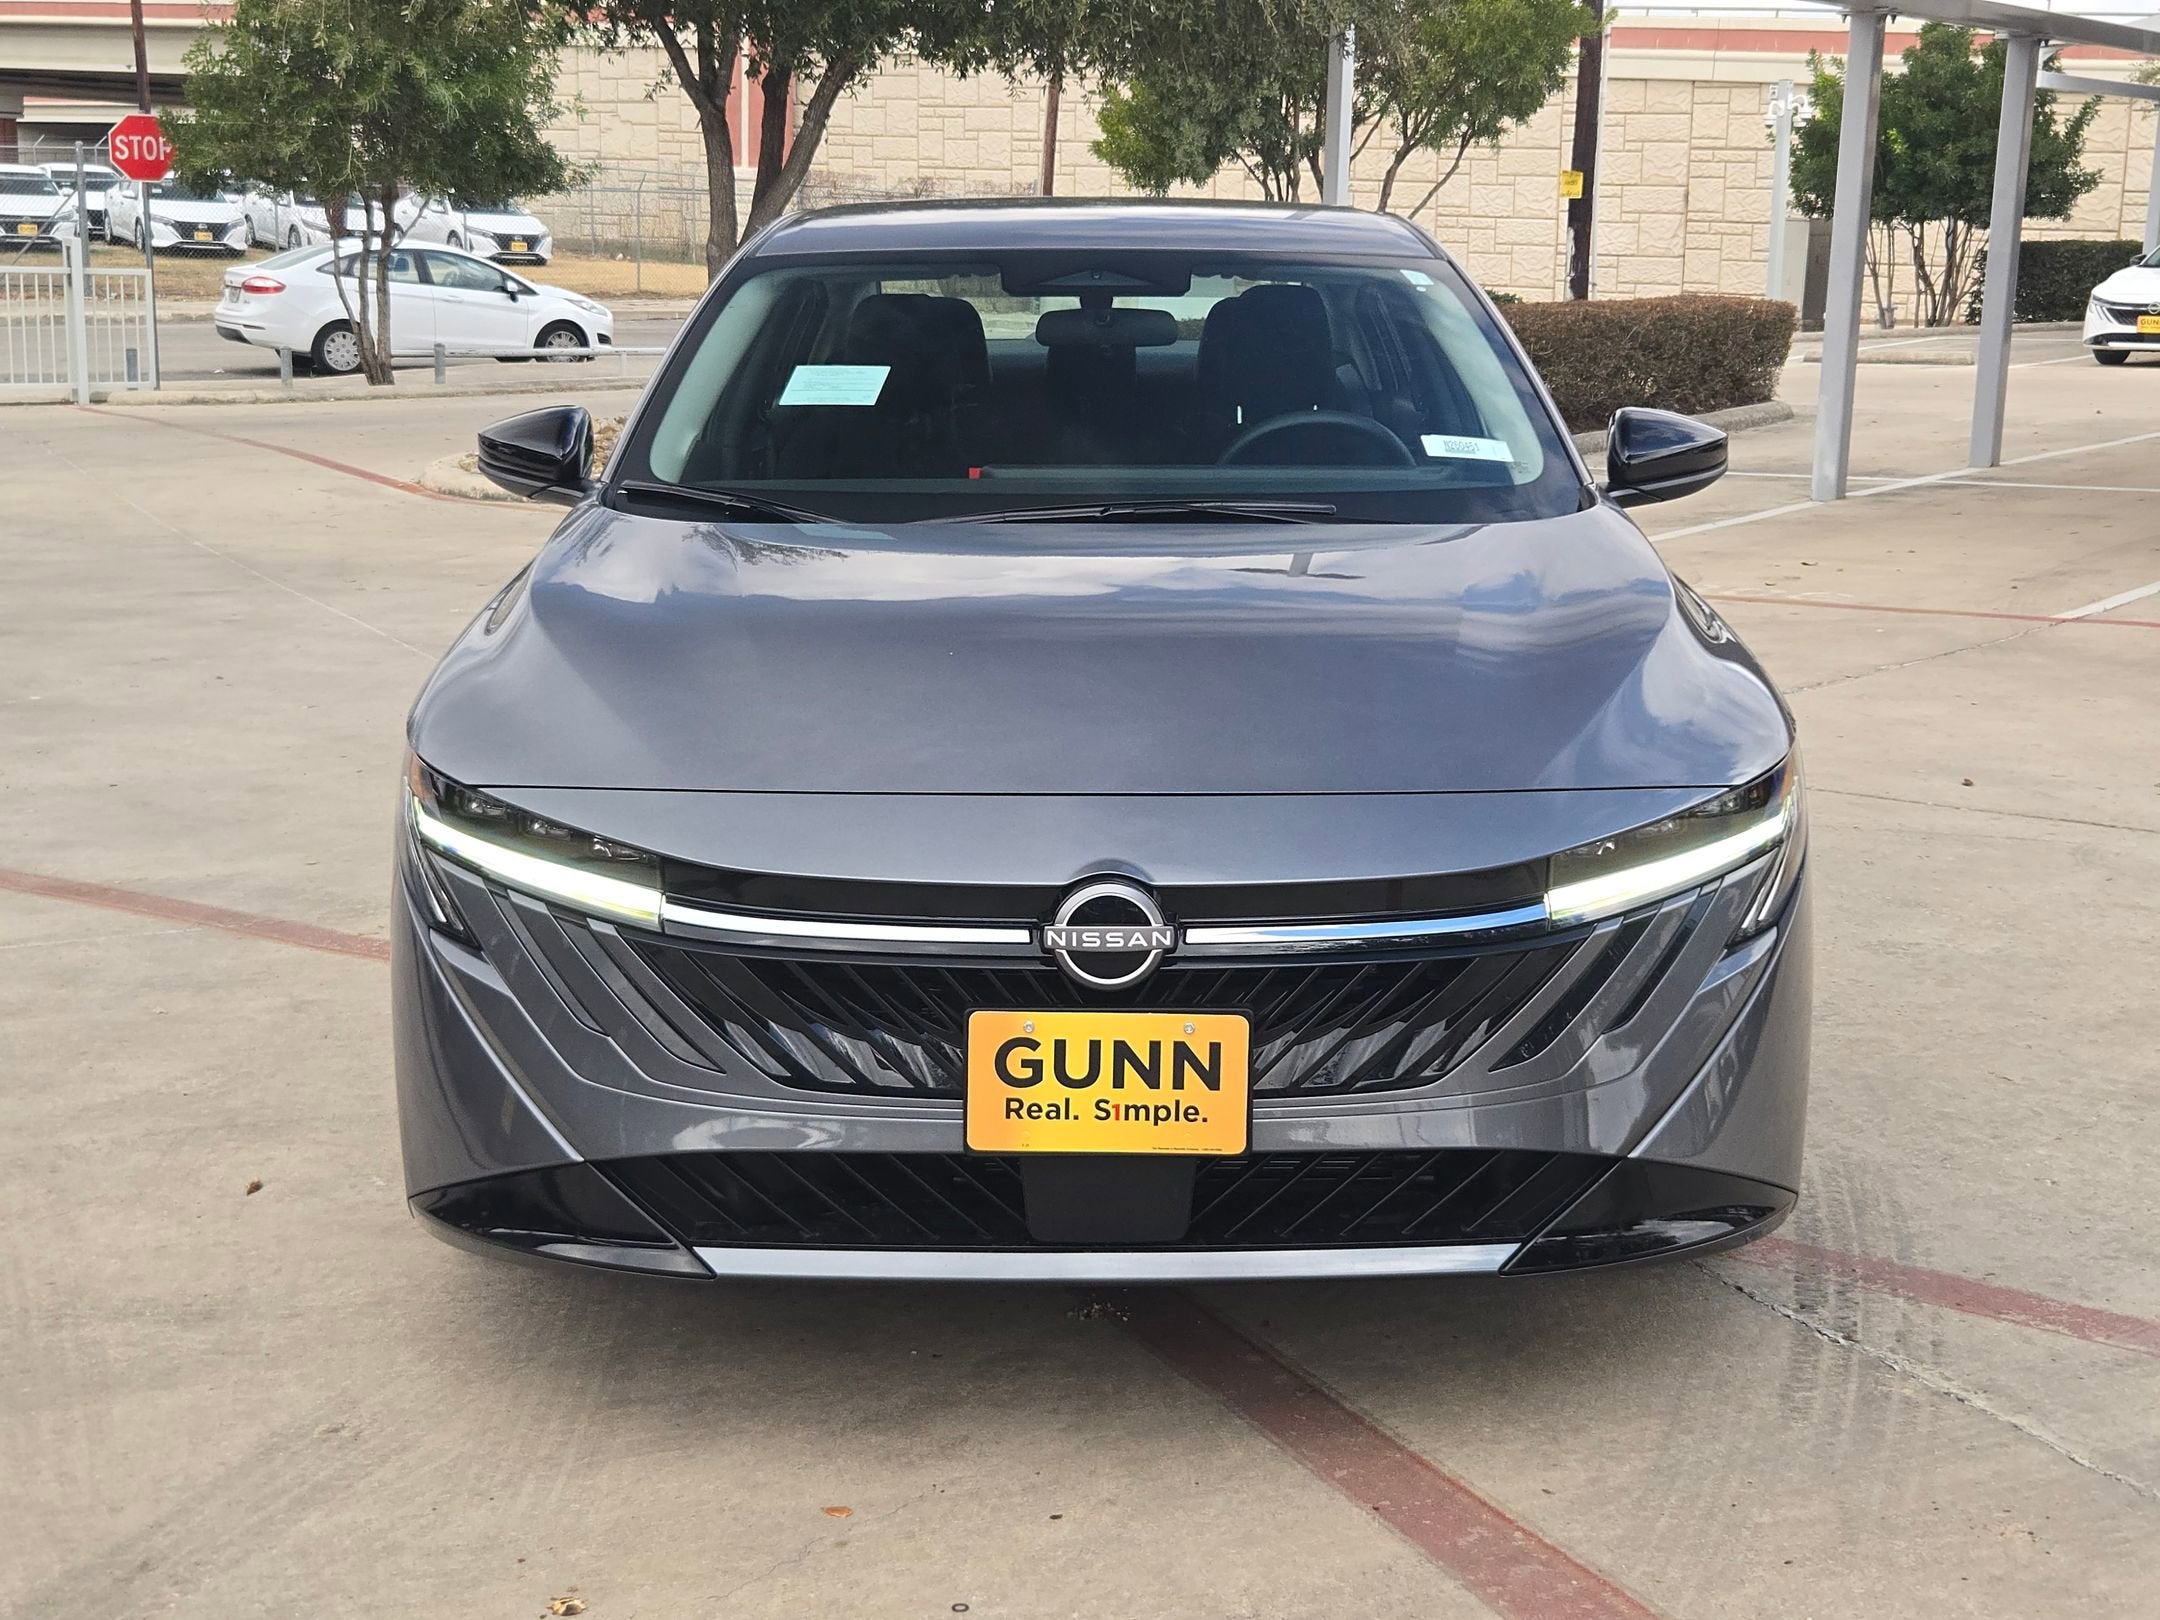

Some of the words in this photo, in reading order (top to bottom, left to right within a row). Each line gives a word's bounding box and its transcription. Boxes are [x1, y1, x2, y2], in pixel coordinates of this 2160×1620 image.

[115, 135, 172, 160] STOP
[2140, 318, 2160, 326] GUN
[1047, 930, 1172, 948] NISSAN
[994, 1036, 1222, 1091] GUNN
[1005, 1097, 1079, 1120] Real.
